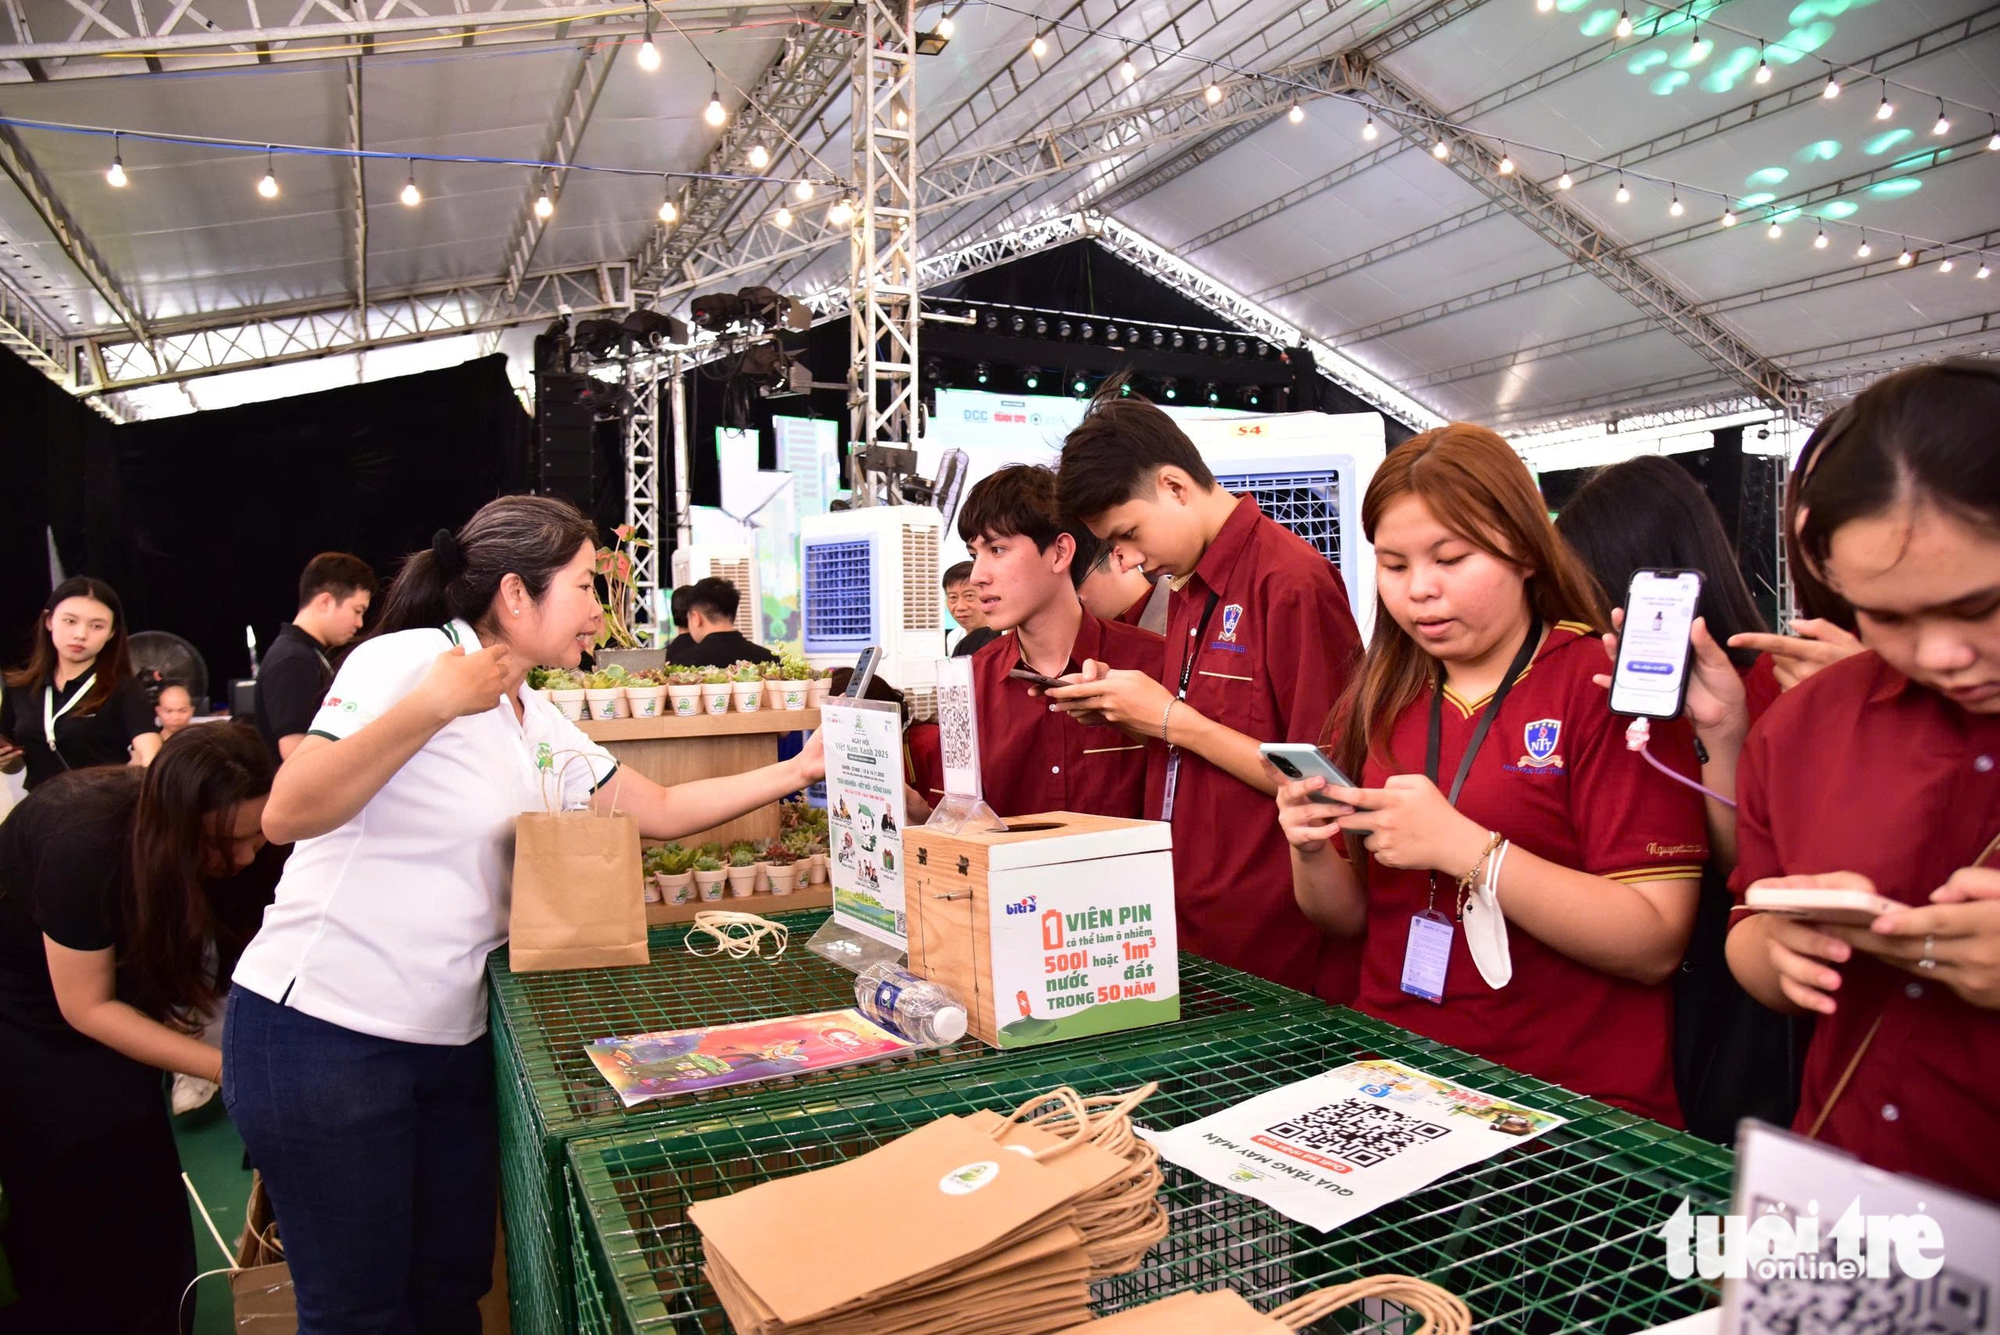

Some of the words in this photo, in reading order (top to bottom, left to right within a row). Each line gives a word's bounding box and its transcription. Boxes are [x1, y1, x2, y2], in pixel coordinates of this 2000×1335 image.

[964, 409, 988, 421] DCC
[1237, 425, 1262, 436] S4
[1531, 738, 1553, 751] NTT
[874, 749, 889, 759] 2025
[1065, 906, 1113, 932] VIÊN
[1119, 903, 1152, 925] PIN
[1066, 935, 1077, 948] có
[1079, 932, 1095, 946] thể
[1096, 930, 1114, 944] làm
[1116, 930, 1122, 941] ô
[1124, 926, 1153, 940] nhiễm
[1092, 954, 1119, 968] hoặc
[1046, 970, 1088, 993] nước
[1124, 961, 1154, 981] đất
[1047, 991, 1095, 1010] TRONG
[1098, 984, 1121, 1003] 50
[1124, 981, 1156, 998] NĂM
[1202, 1133, 1240, 1150] MẮN
[1236, 1149, 1273, 1164] MAY
[1271, 1161, 1316, 1182] TẶNG
[1316, 1178, 1354, 1197] QUÀ
